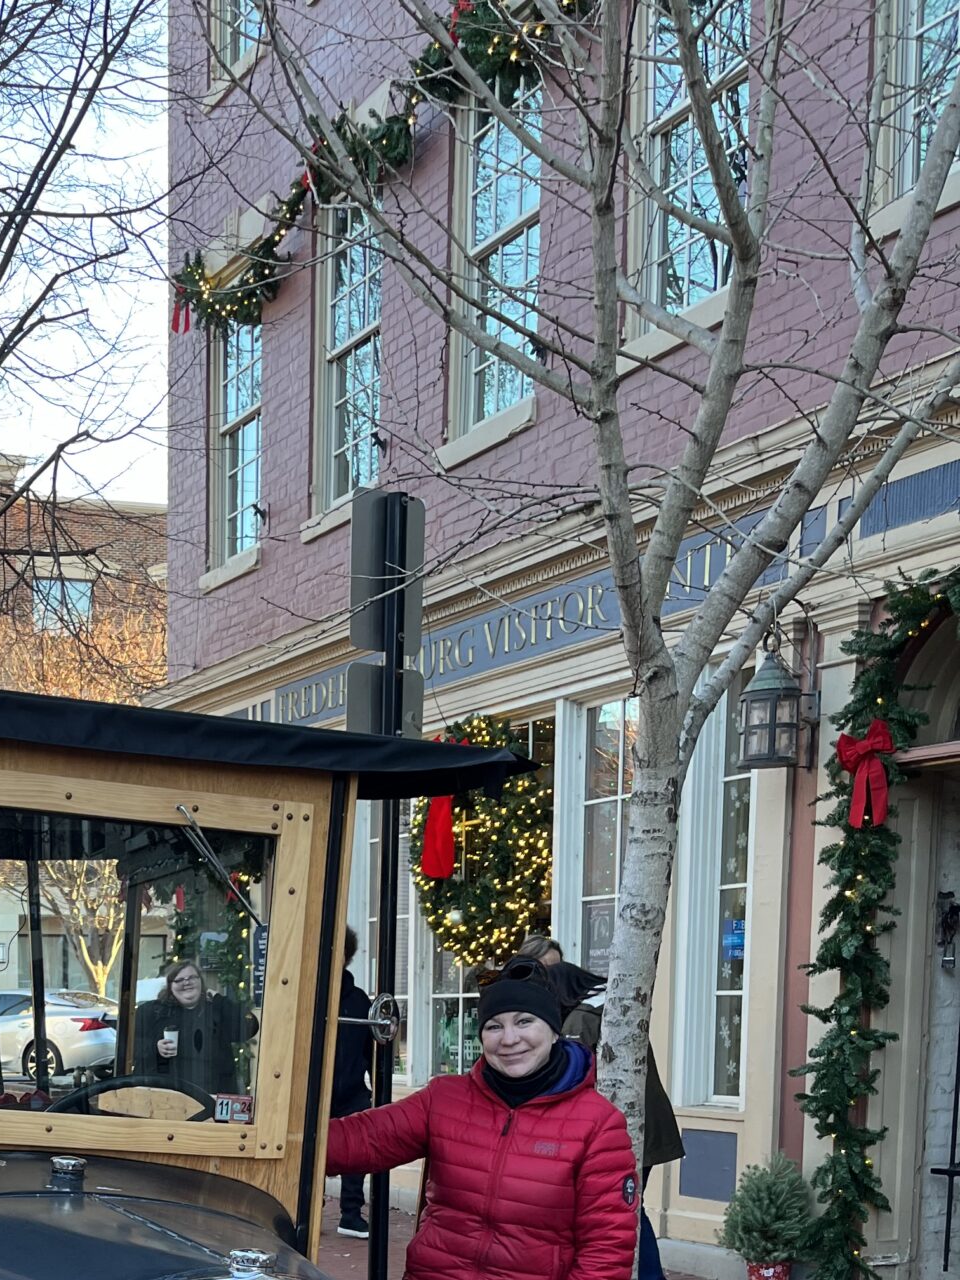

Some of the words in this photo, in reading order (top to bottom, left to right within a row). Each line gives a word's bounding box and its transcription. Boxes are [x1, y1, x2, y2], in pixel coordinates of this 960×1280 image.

[484, 584, 609, 659] VISITOR
[218, 1100, 230, 1116] 11
[241, 1101, 252, 1114] 24
